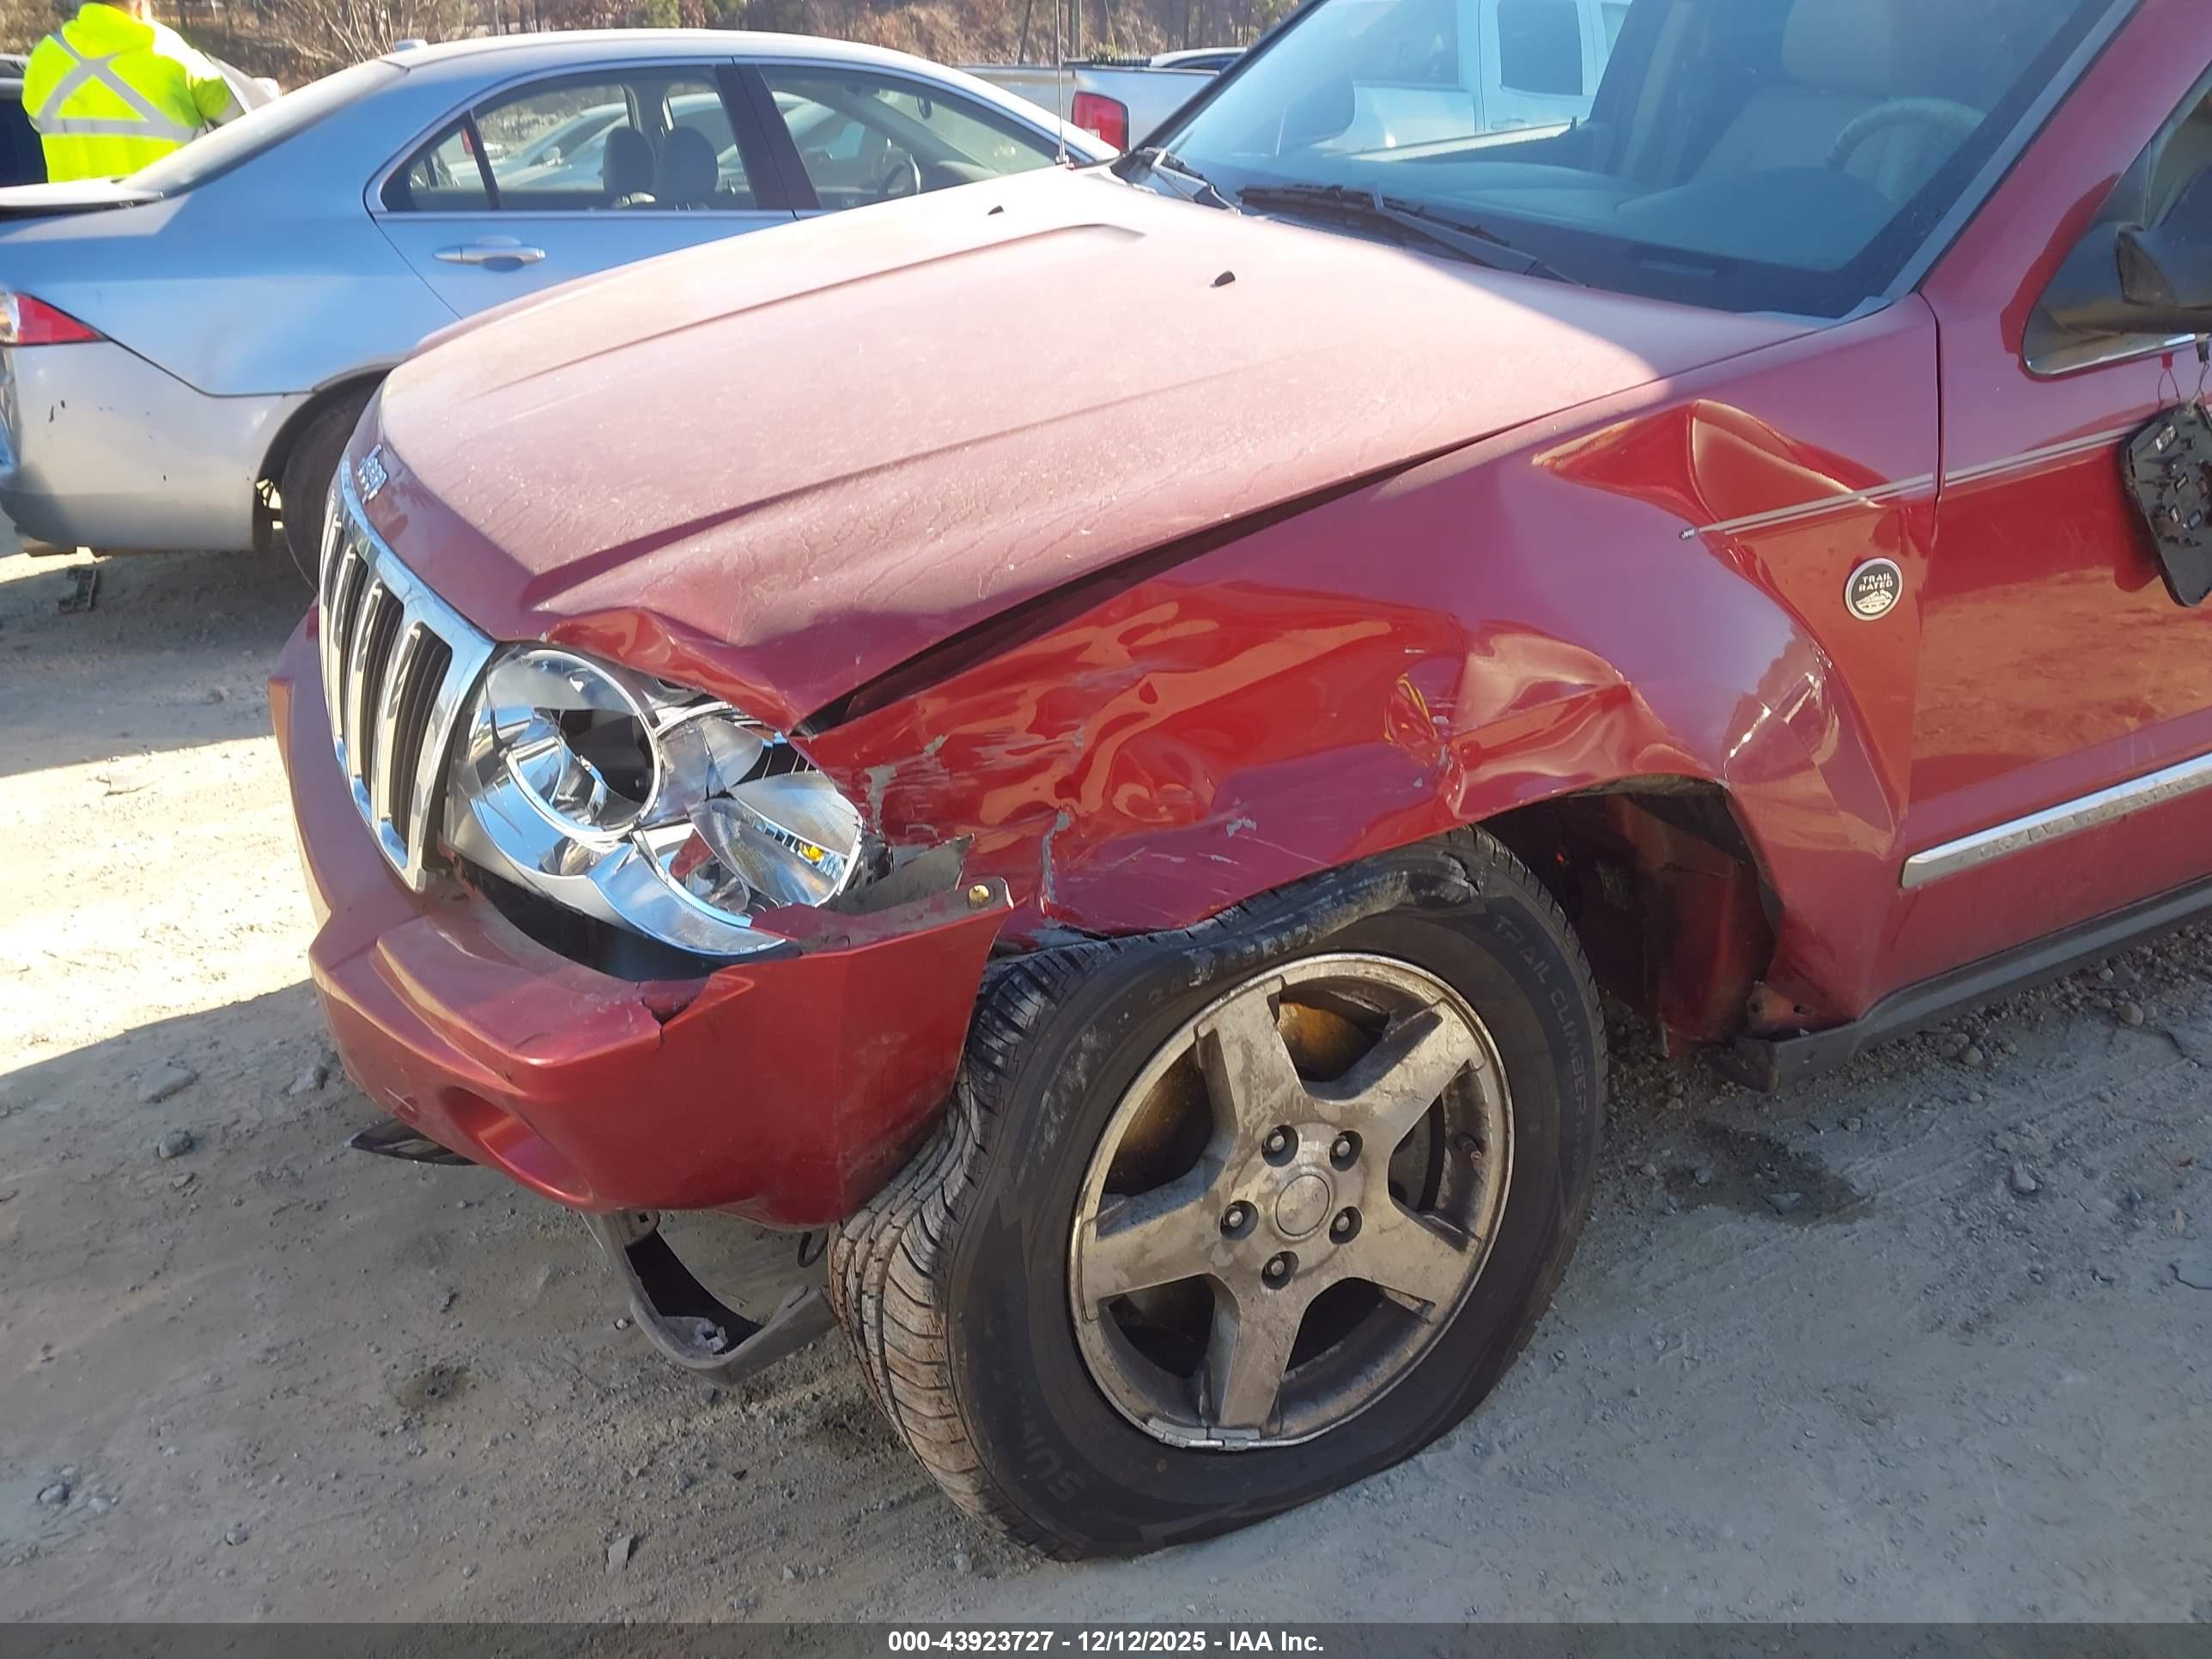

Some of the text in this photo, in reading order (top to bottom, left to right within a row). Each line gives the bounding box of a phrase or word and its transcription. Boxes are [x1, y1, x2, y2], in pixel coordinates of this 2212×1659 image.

[1862, 572, 1893, 585] TRAIL
[1858, 580, 1893, 592] RATED
[1493, 915, 1587, 1115] TRAIL CLIMBER
